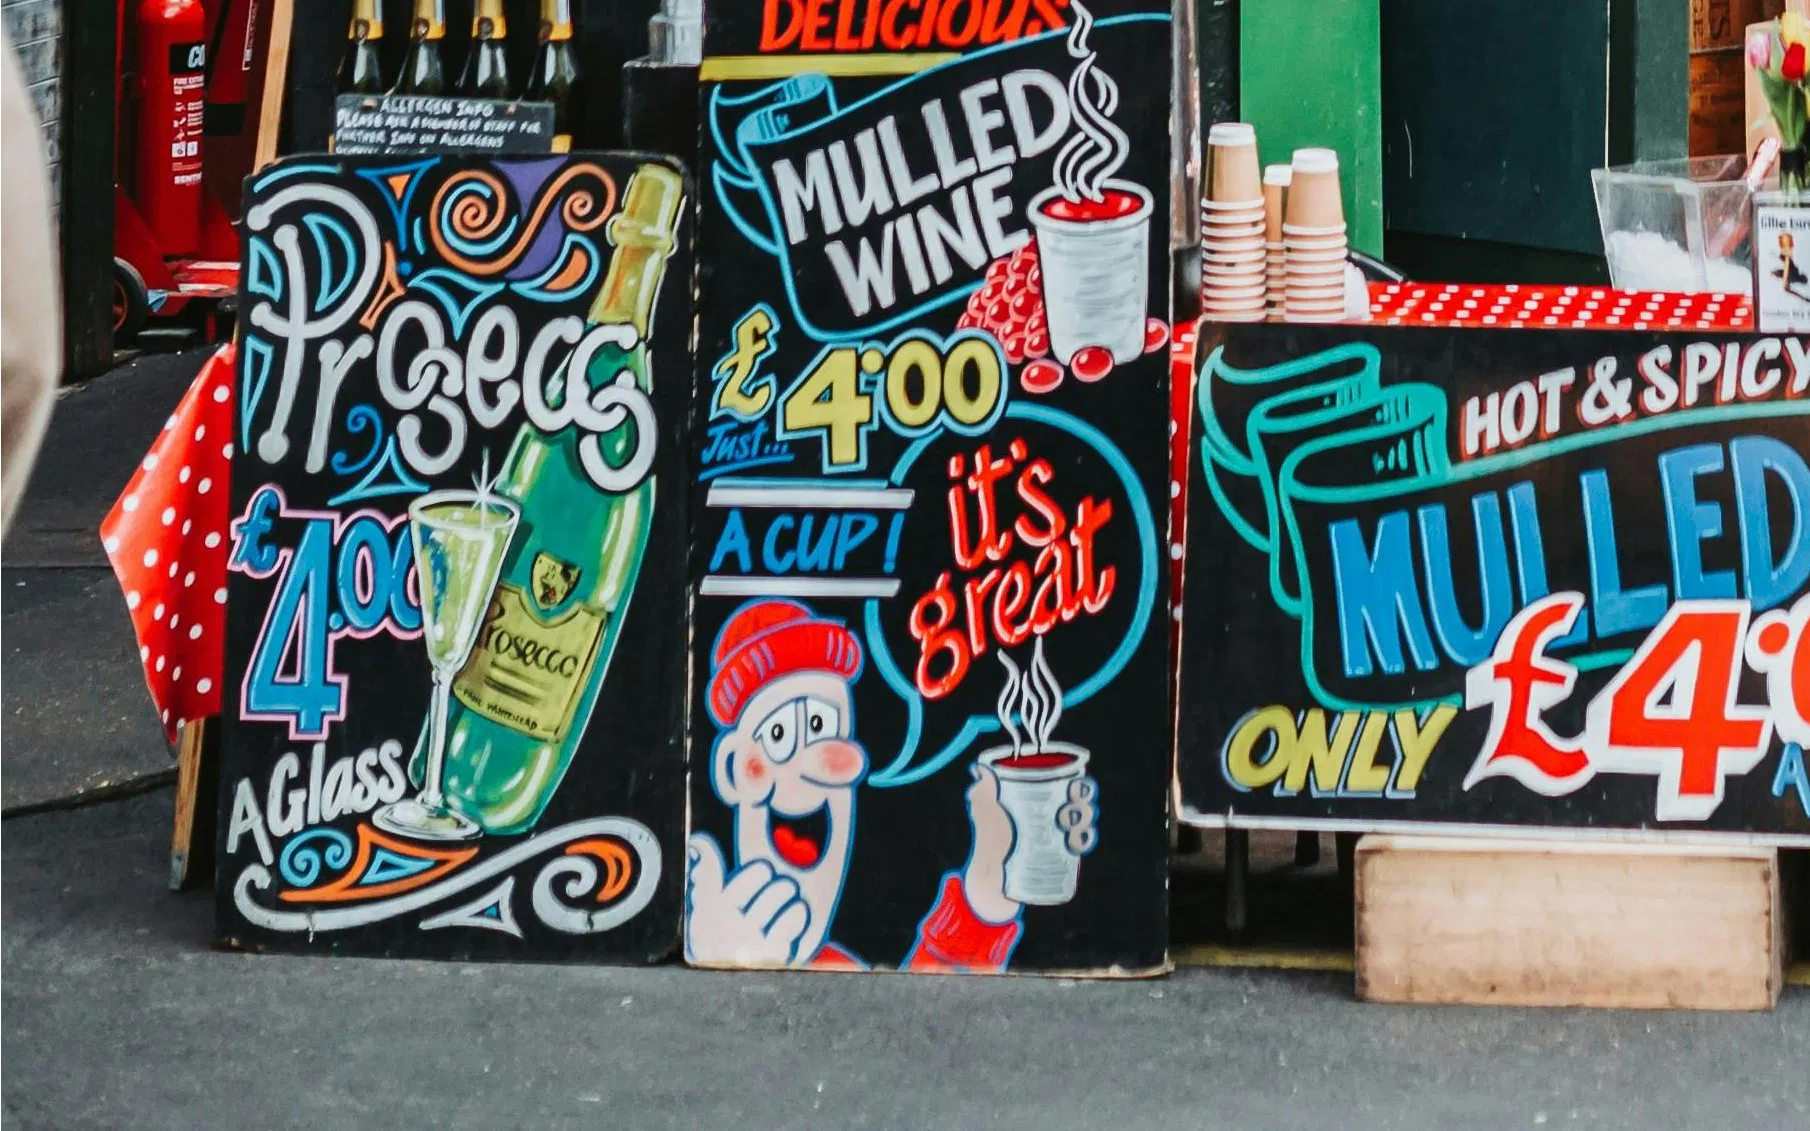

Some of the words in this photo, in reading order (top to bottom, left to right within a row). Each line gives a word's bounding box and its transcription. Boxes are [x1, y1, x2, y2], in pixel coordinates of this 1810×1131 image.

[379, 96, 454, 115] ALLERGEN
[438, 133, 505, 149] ALLERGENS
[771, 68, 1073, 245] MULLED
[823, 164, 1030, 319] WINE
[249, 183, 660, 495] Prosecco
[1459, 363, 1574, 460] HOT
[1577, 365, 1634, 430] &
[709, 511, 752, 574] A
[946, 434, 1058, 568] it's
[911, 495, 1121, 704] great
[226, 776, 271, 870] A
[268, 737, 408, 843] Glass
[1221, 703, 1458, 798] ONLY
